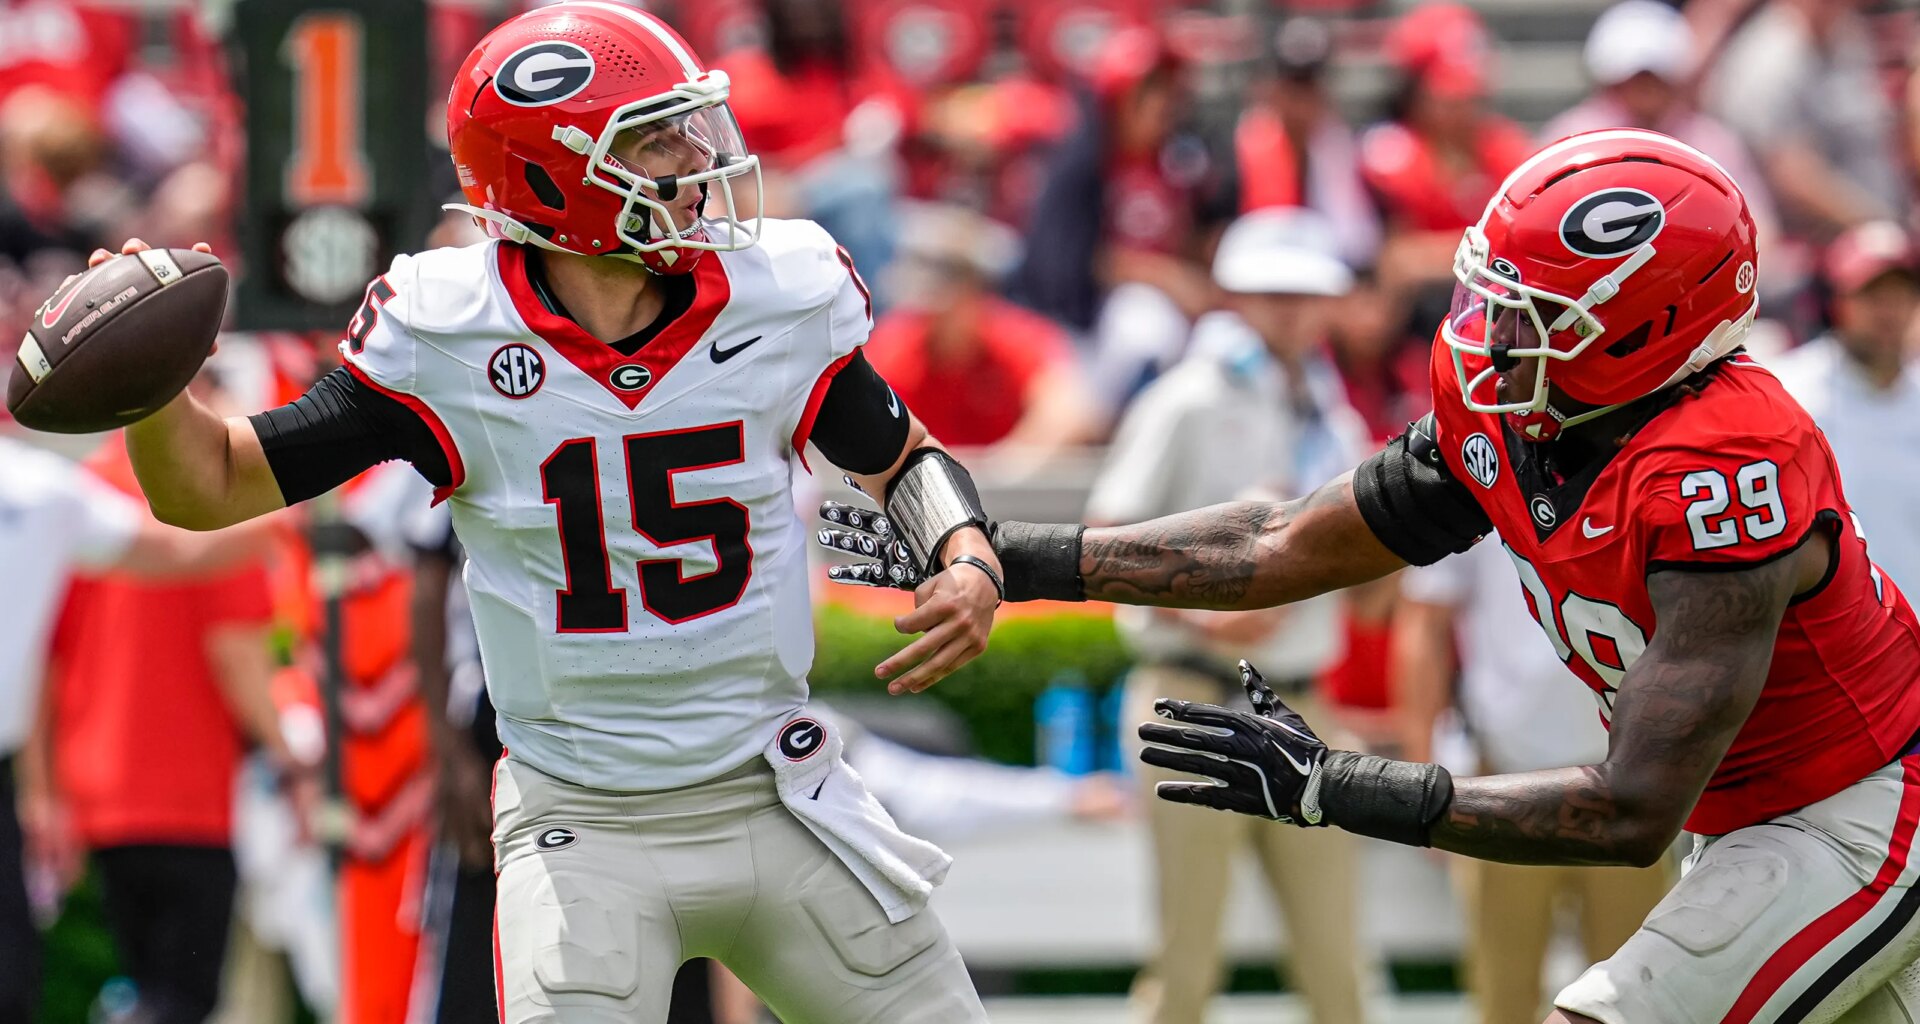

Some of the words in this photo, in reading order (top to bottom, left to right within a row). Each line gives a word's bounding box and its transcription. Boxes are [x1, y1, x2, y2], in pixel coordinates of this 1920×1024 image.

[503, 45, 595, 102] G
[283, 14, 374, 205] 1
[1570, 192, 1664, 252] G
[1738, 263, 1752, 290] SEC
[62, 308, 102, 345] VAPOR
[99, 286, 138, 316] ELITE
[491, 346, 543, 397] SEC
[614, 366, 652, 390] G
[1465, 435, 1497, 487] SEC
[540, 420, 753, 634] 15
[1533, 499, 1556, 525] G
[1681, 460, 1788, 550] 29
[782, 721, 826, 758] G
[537, 829, 579, 850] G
